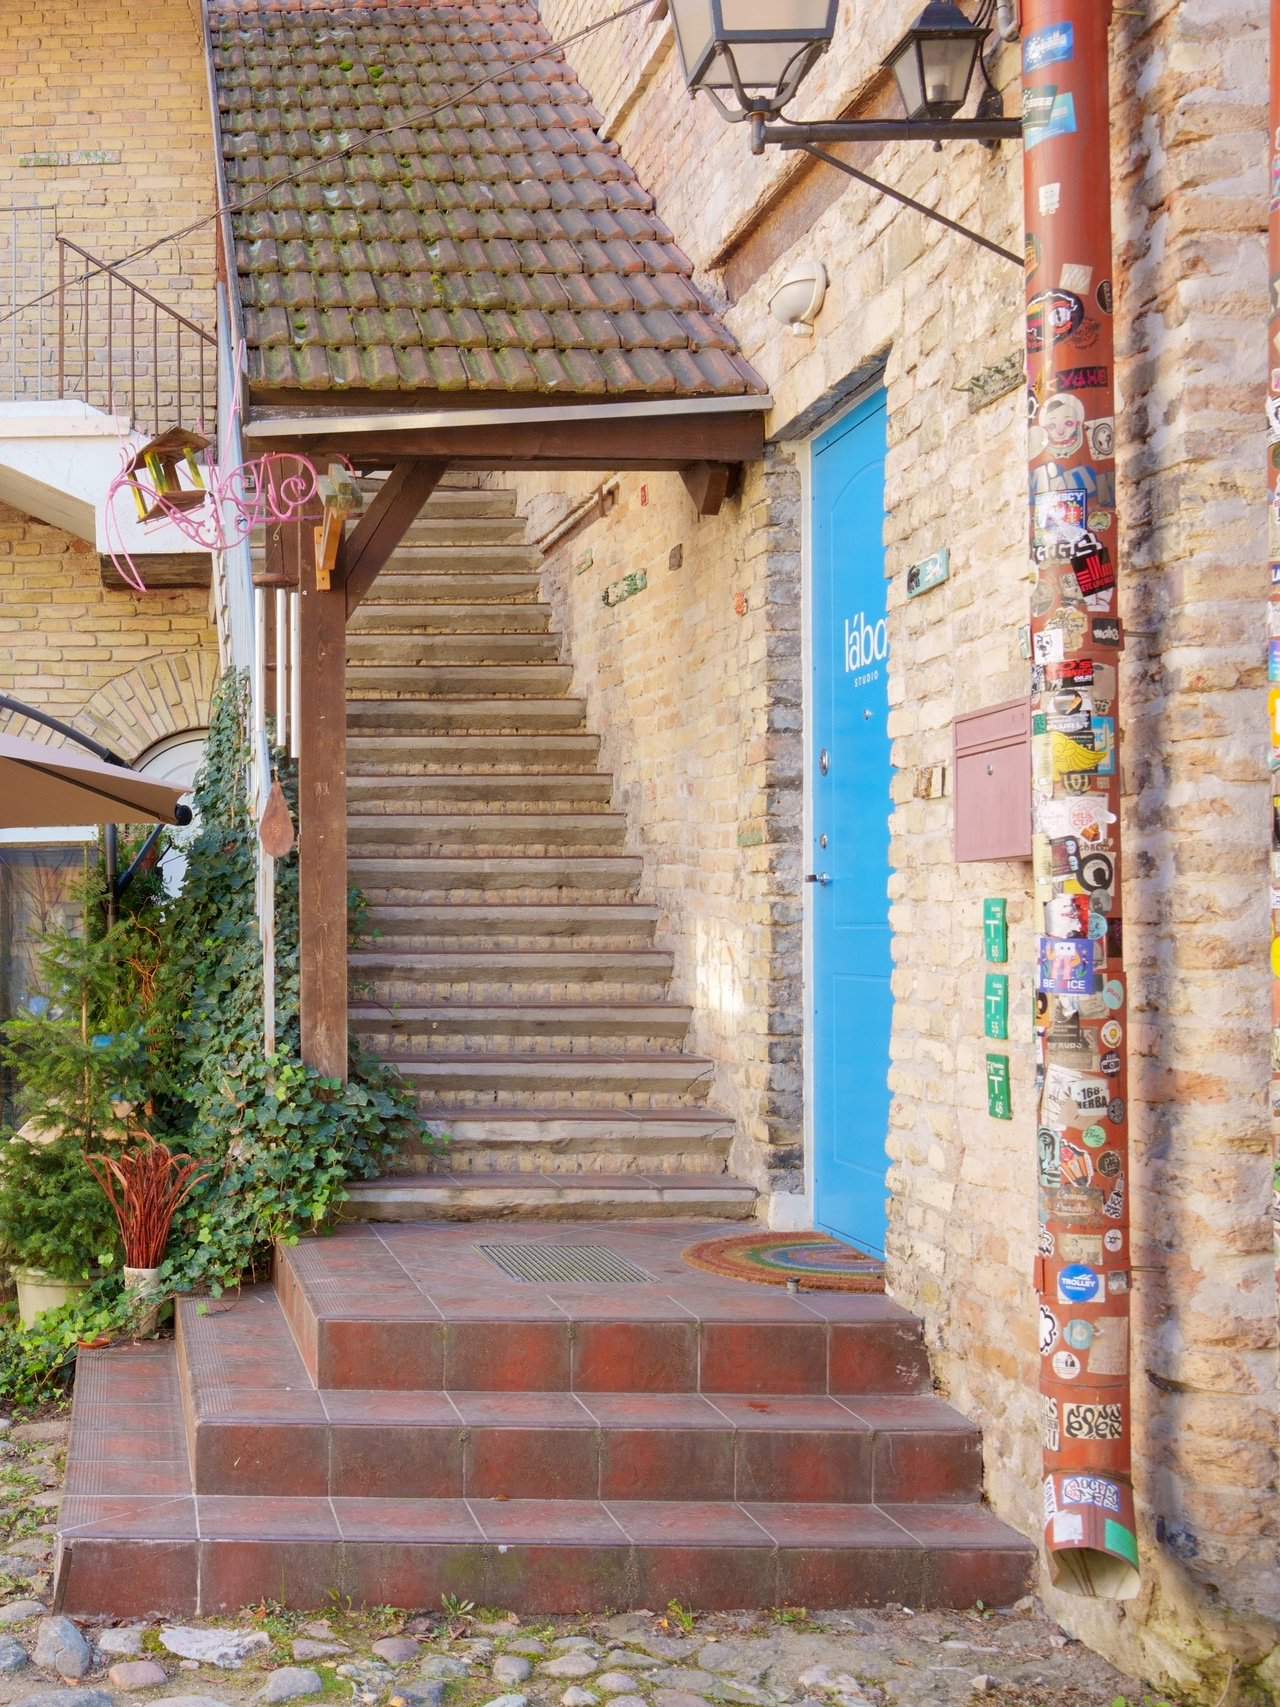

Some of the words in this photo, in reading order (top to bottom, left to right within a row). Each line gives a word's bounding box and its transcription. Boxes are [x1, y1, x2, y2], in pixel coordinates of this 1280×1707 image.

[854, 670, 879, 688] STUDIO
[1042, 979, 1055, 988] BE
[1061, 1277, 1095, 1288] TROLLEY
